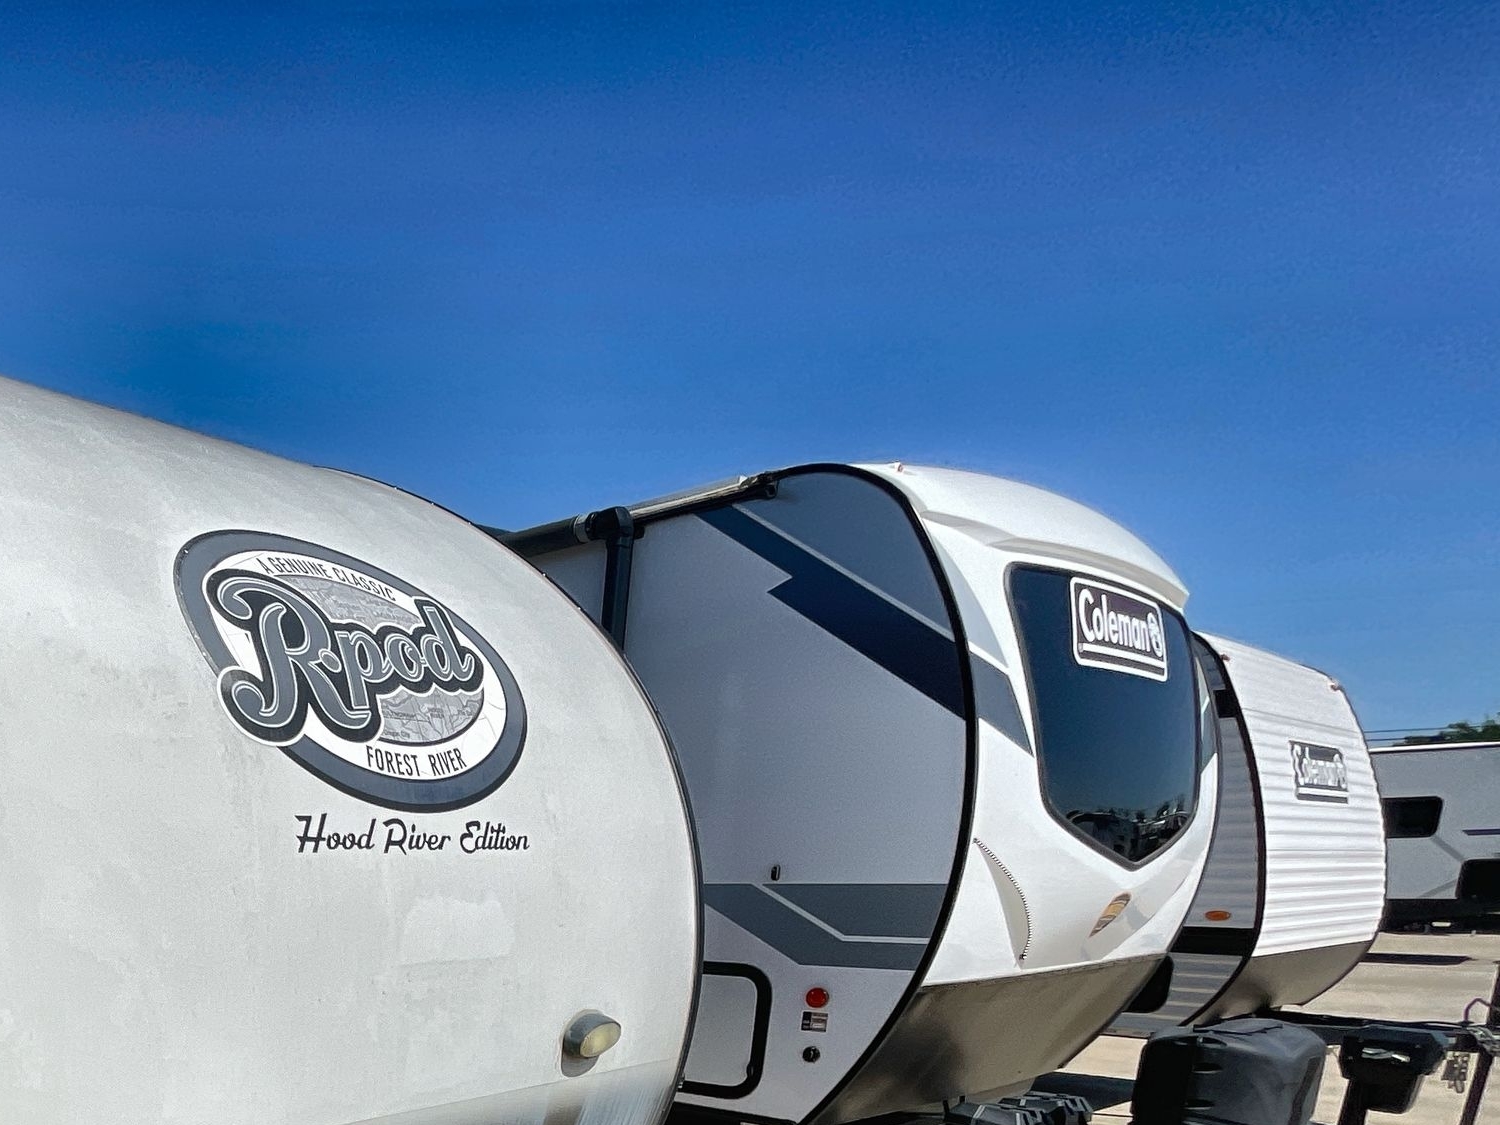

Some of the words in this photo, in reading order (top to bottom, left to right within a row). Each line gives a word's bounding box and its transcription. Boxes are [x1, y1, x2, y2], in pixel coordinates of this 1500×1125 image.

[256, 557, 271, 576] A
[270, 557, 332, 579] GENUINE
[333, 567, 397, 602] CLASSIC
[1078, 588, 1152, 653] Coleman
[366, 745, 420, 777] FOREST
[431, 748, 467, 777] RIVER
[294, 813, 376, 854] Hood
[383, 818, 451, 855] River
[459, 821, 530, 855] Edition
